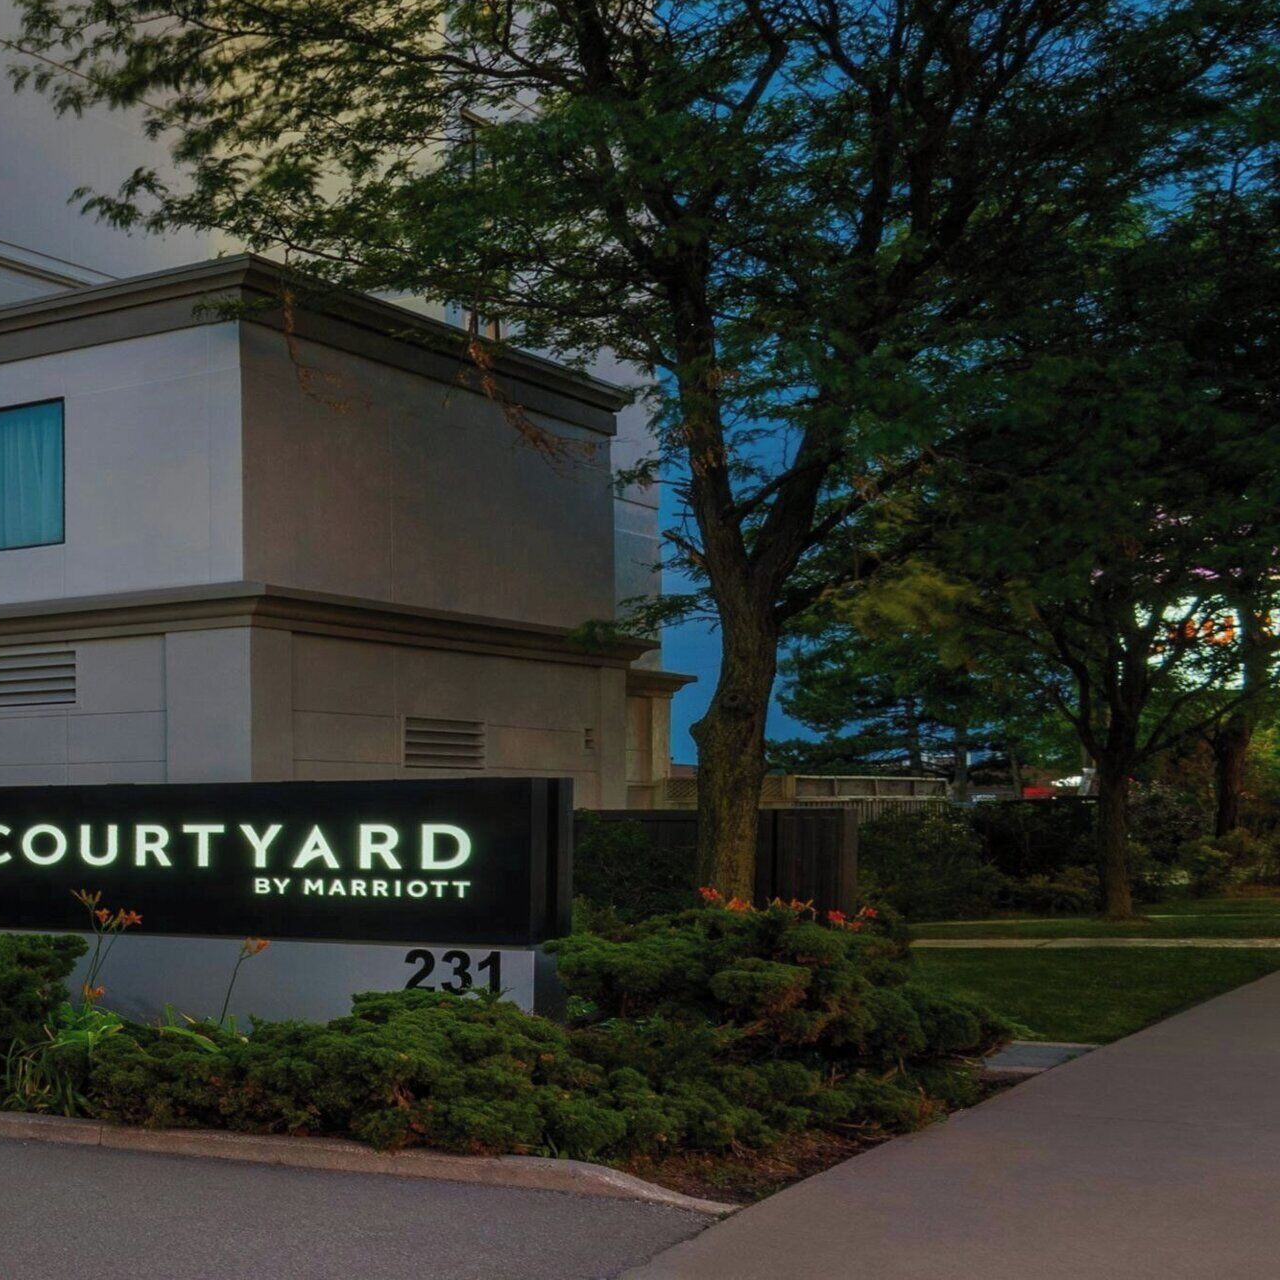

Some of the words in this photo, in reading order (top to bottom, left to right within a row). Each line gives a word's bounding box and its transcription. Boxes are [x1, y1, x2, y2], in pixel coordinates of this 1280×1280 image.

[254, 877, 291, 895] BY
[303, 878, 472, 899] MARRIOTT
[404, 948, 502, 996] 231
